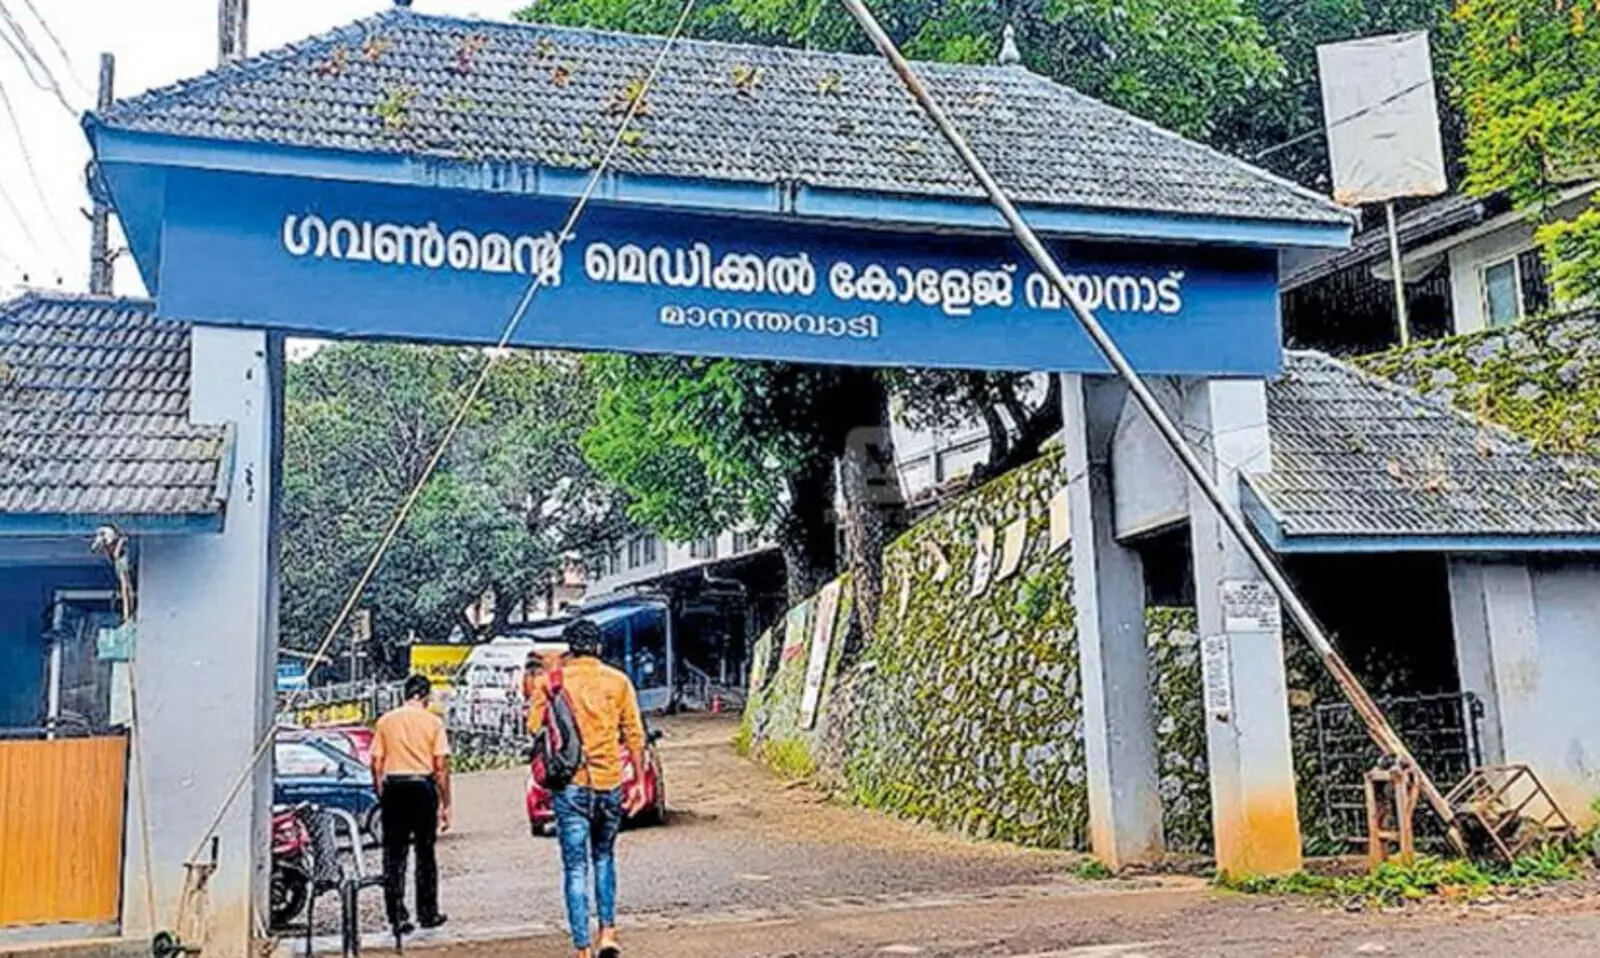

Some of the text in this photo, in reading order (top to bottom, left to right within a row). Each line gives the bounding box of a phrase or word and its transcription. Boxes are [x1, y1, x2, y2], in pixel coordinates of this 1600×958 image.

[585, 241, 816, 296] മെഡിക്കൽ
[829, 261, 1017, 316] കോളേജ്
[1025, 270, 1185, 314] വയനാട്
[660, 304, 879, 338] മാനന്തവാടി
